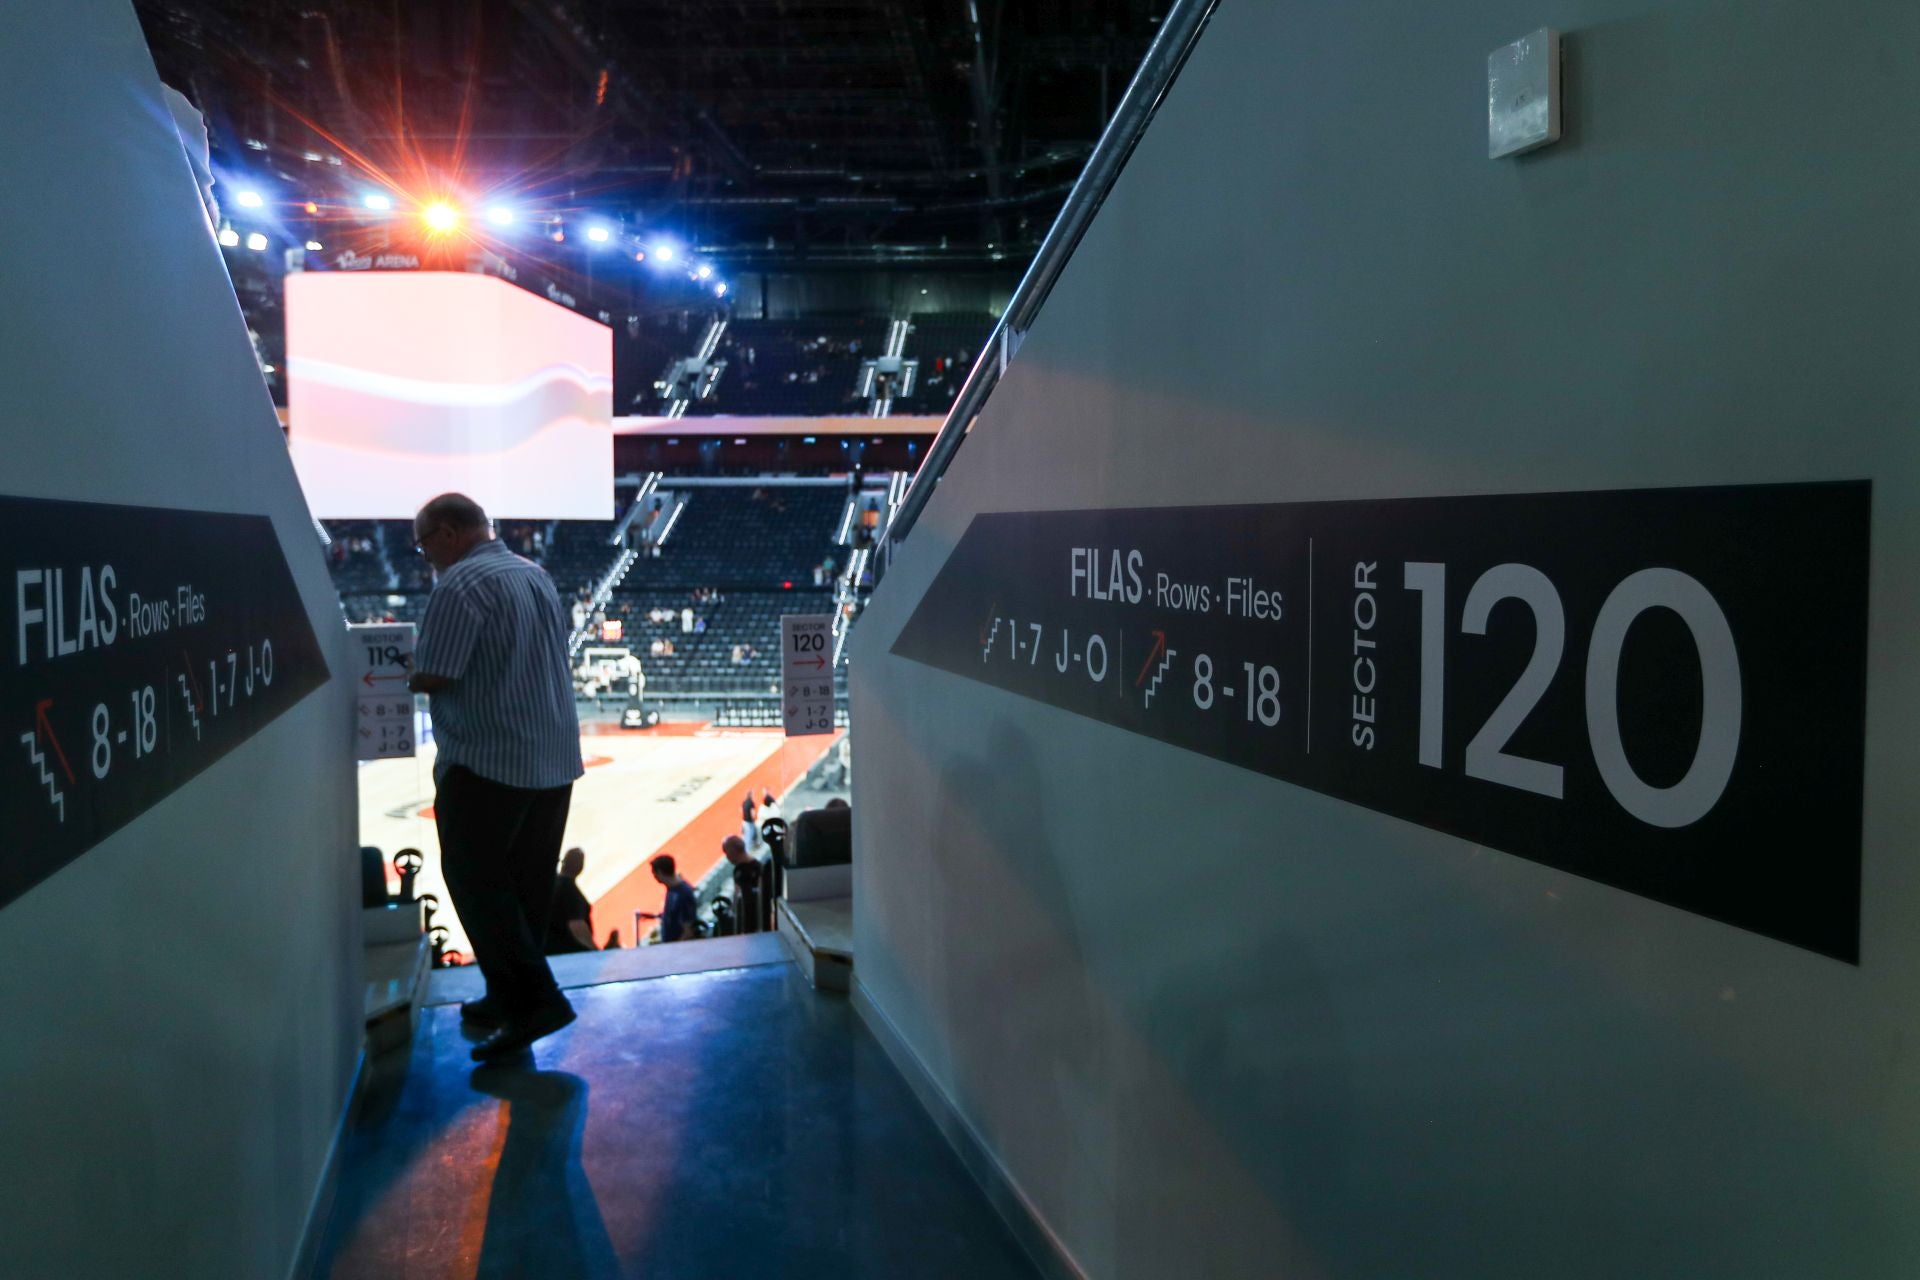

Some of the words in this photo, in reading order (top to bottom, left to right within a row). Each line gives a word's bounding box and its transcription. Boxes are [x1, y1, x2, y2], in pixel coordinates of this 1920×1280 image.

[1071, 547, 1143, 604] FILAS
[1157, 573, 1210, 612] Rows
[1227, 577, 1283, 621] Files
[17, 564, 118, 665] FILAS
[130, 592, 170, 639] Rows
[177, 584, 206, 627] Files
[792, 624, 825, 632] SECTOR
[362, 634, 404, 644] SECTOR
[367, 645, 401, 667] 119
[792, 633, 824, 652] 120
[1352, 560, 1377, 751] SECTOR
[1404, 561, 1742, 828] 120
